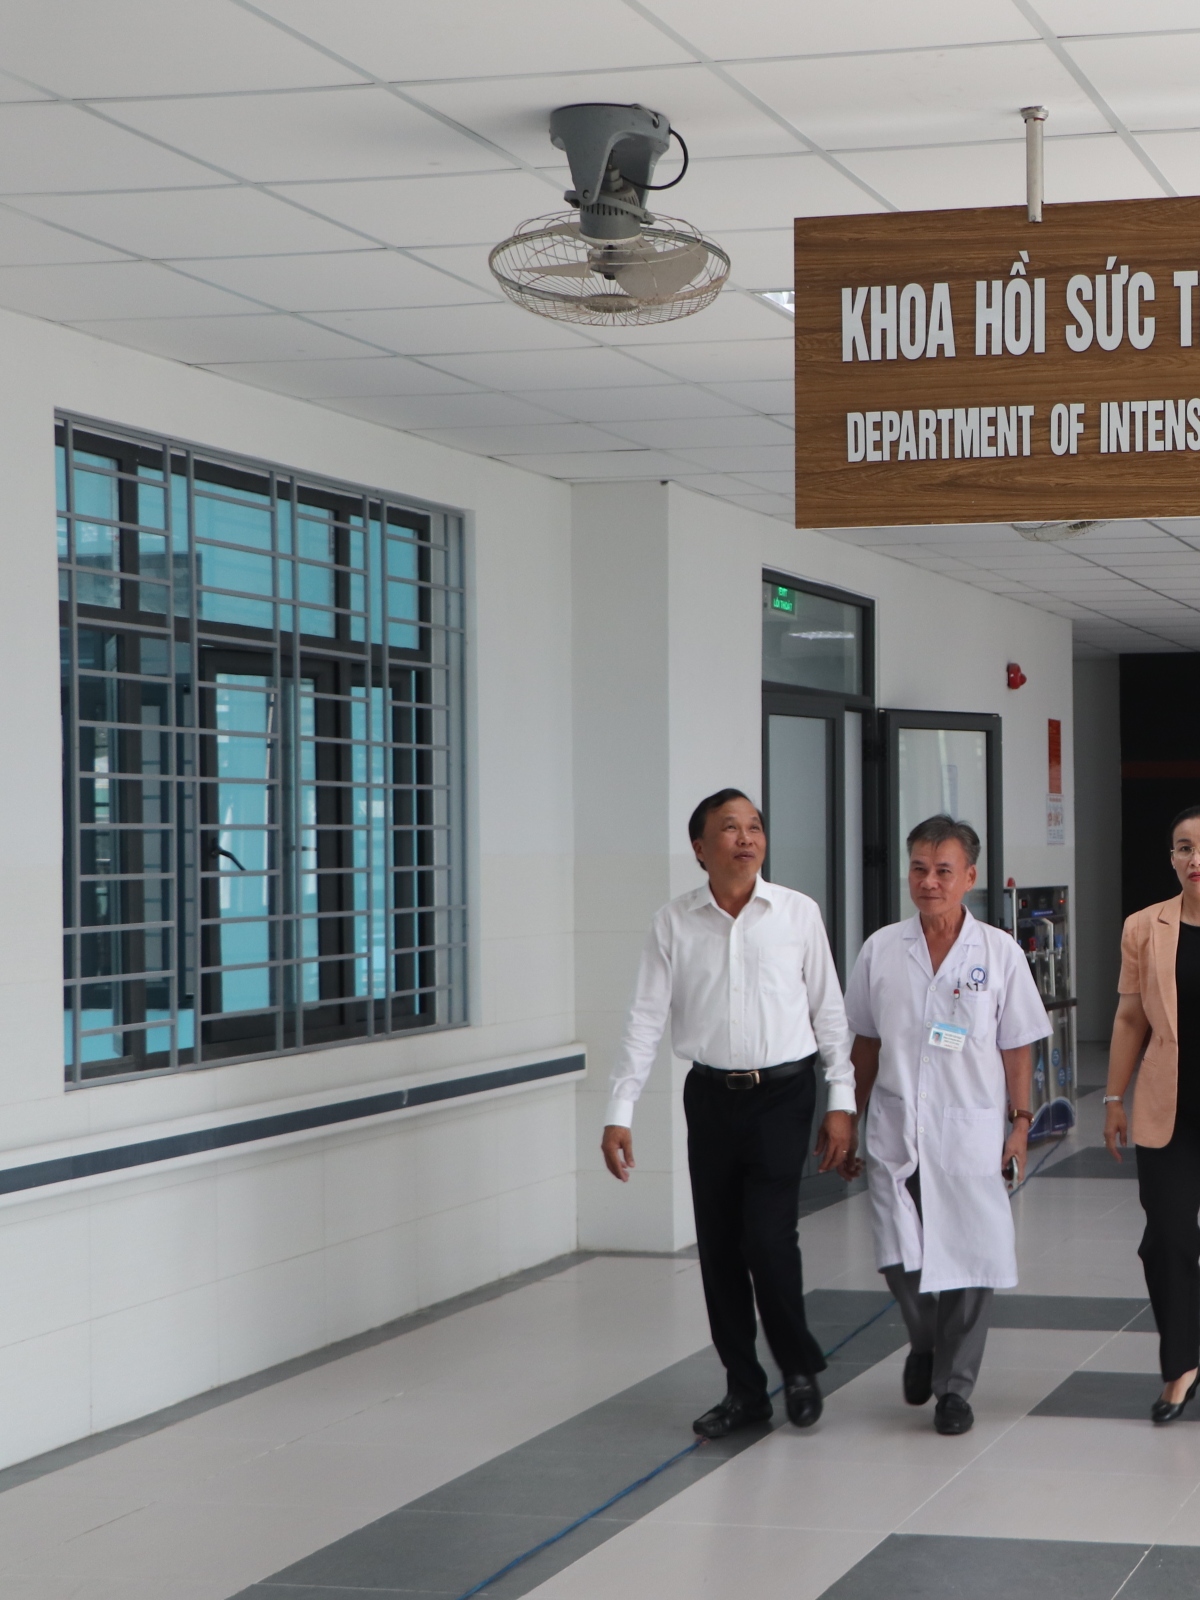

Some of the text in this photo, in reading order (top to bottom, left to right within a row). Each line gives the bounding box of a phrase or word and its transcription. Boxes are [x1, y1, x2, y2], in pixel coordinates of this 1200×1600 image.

[842, 283, 956, 362] KHOA
[975, 251, 1046, 356] HỒI
[1065, 255, 1156, 352] SỨC
[847, 405, 1035, 463] DEPARTMENT
[1050, 403, 1085, 456] OF
[778, 586, 788, 597] EXIT
